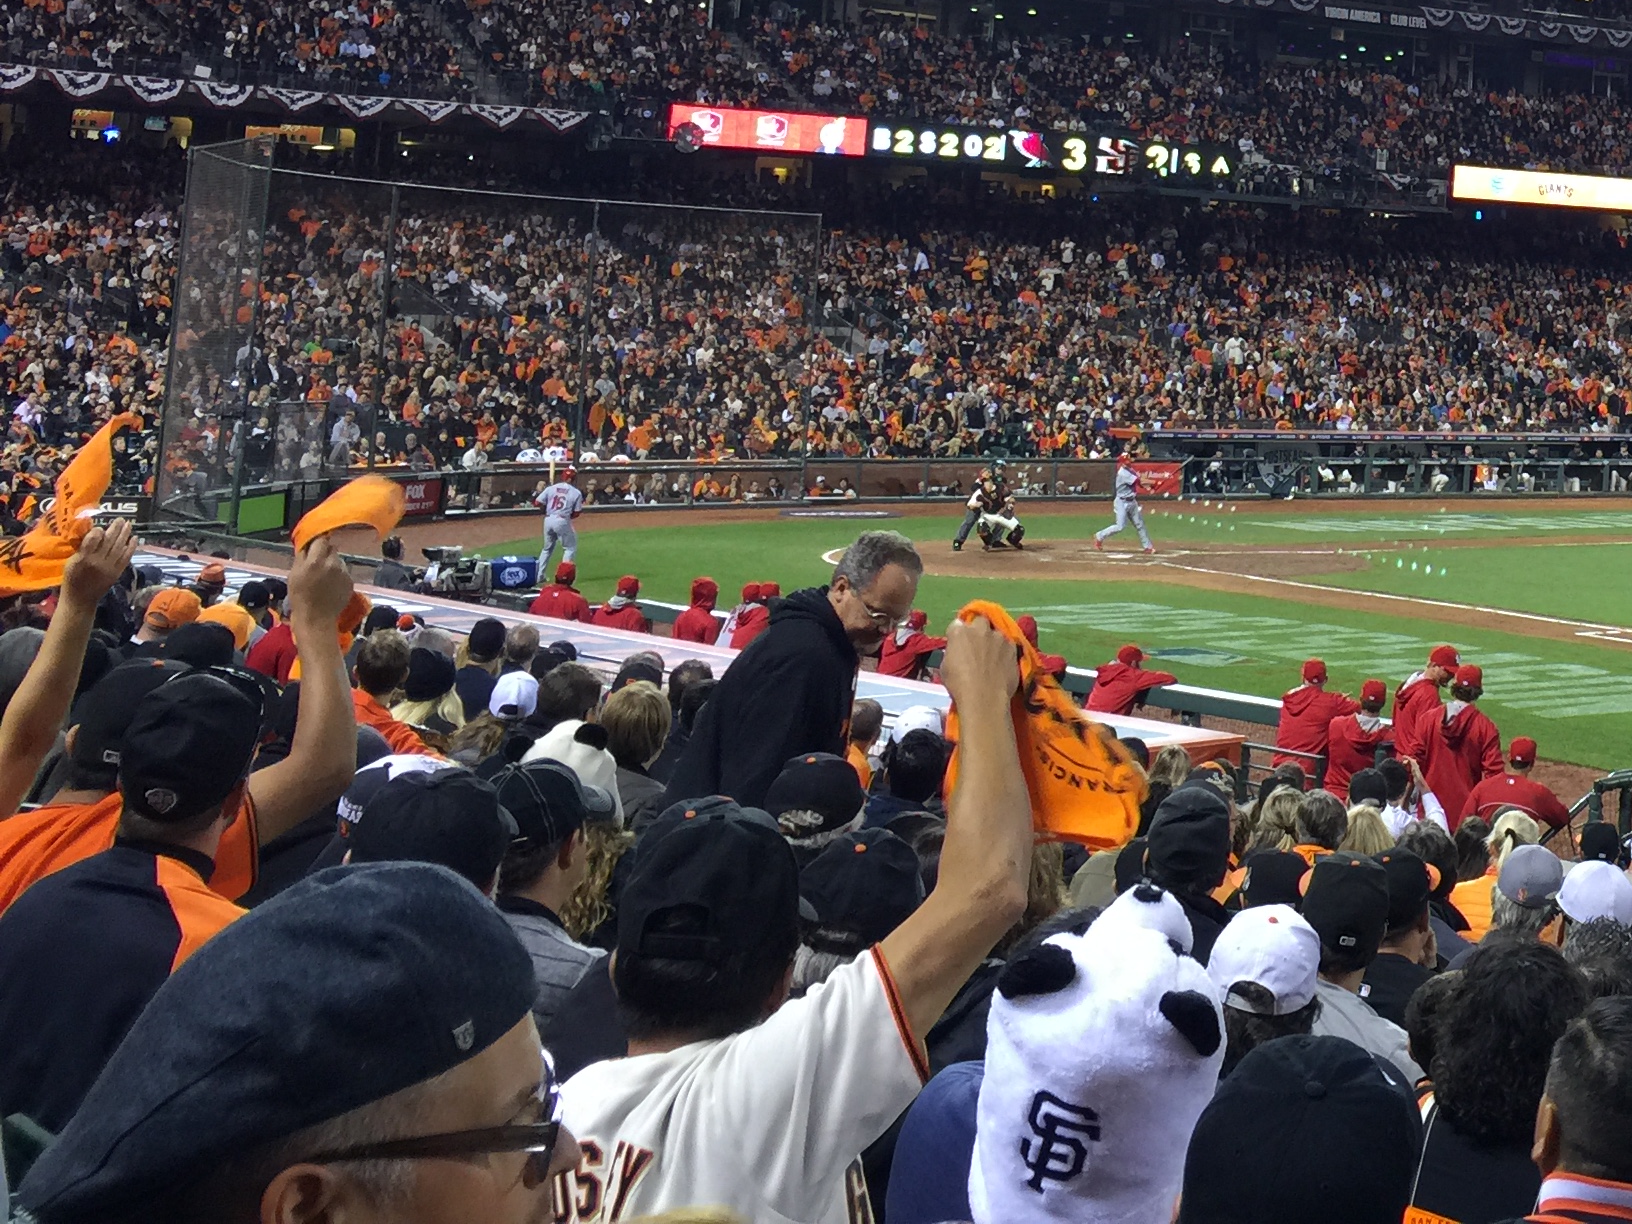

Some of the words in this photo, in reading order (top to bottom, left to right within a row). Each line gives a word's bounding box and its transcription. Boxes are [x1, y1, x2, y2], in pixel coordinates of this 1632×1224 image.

[894, 130, 915, 154] 2
[938, 133, 959, 157] 2
[983, 136, 1002, 161] 2
[1062, 138, 1088, 171] 3
[1538, 184, 1574, 198] GIANTS
[405, 484, 426, 499] FOX
[99, 502, 138, 513] XUS
[551, 494, 566, 510] 16
[1020, 1089, 1101, 1194] SF
